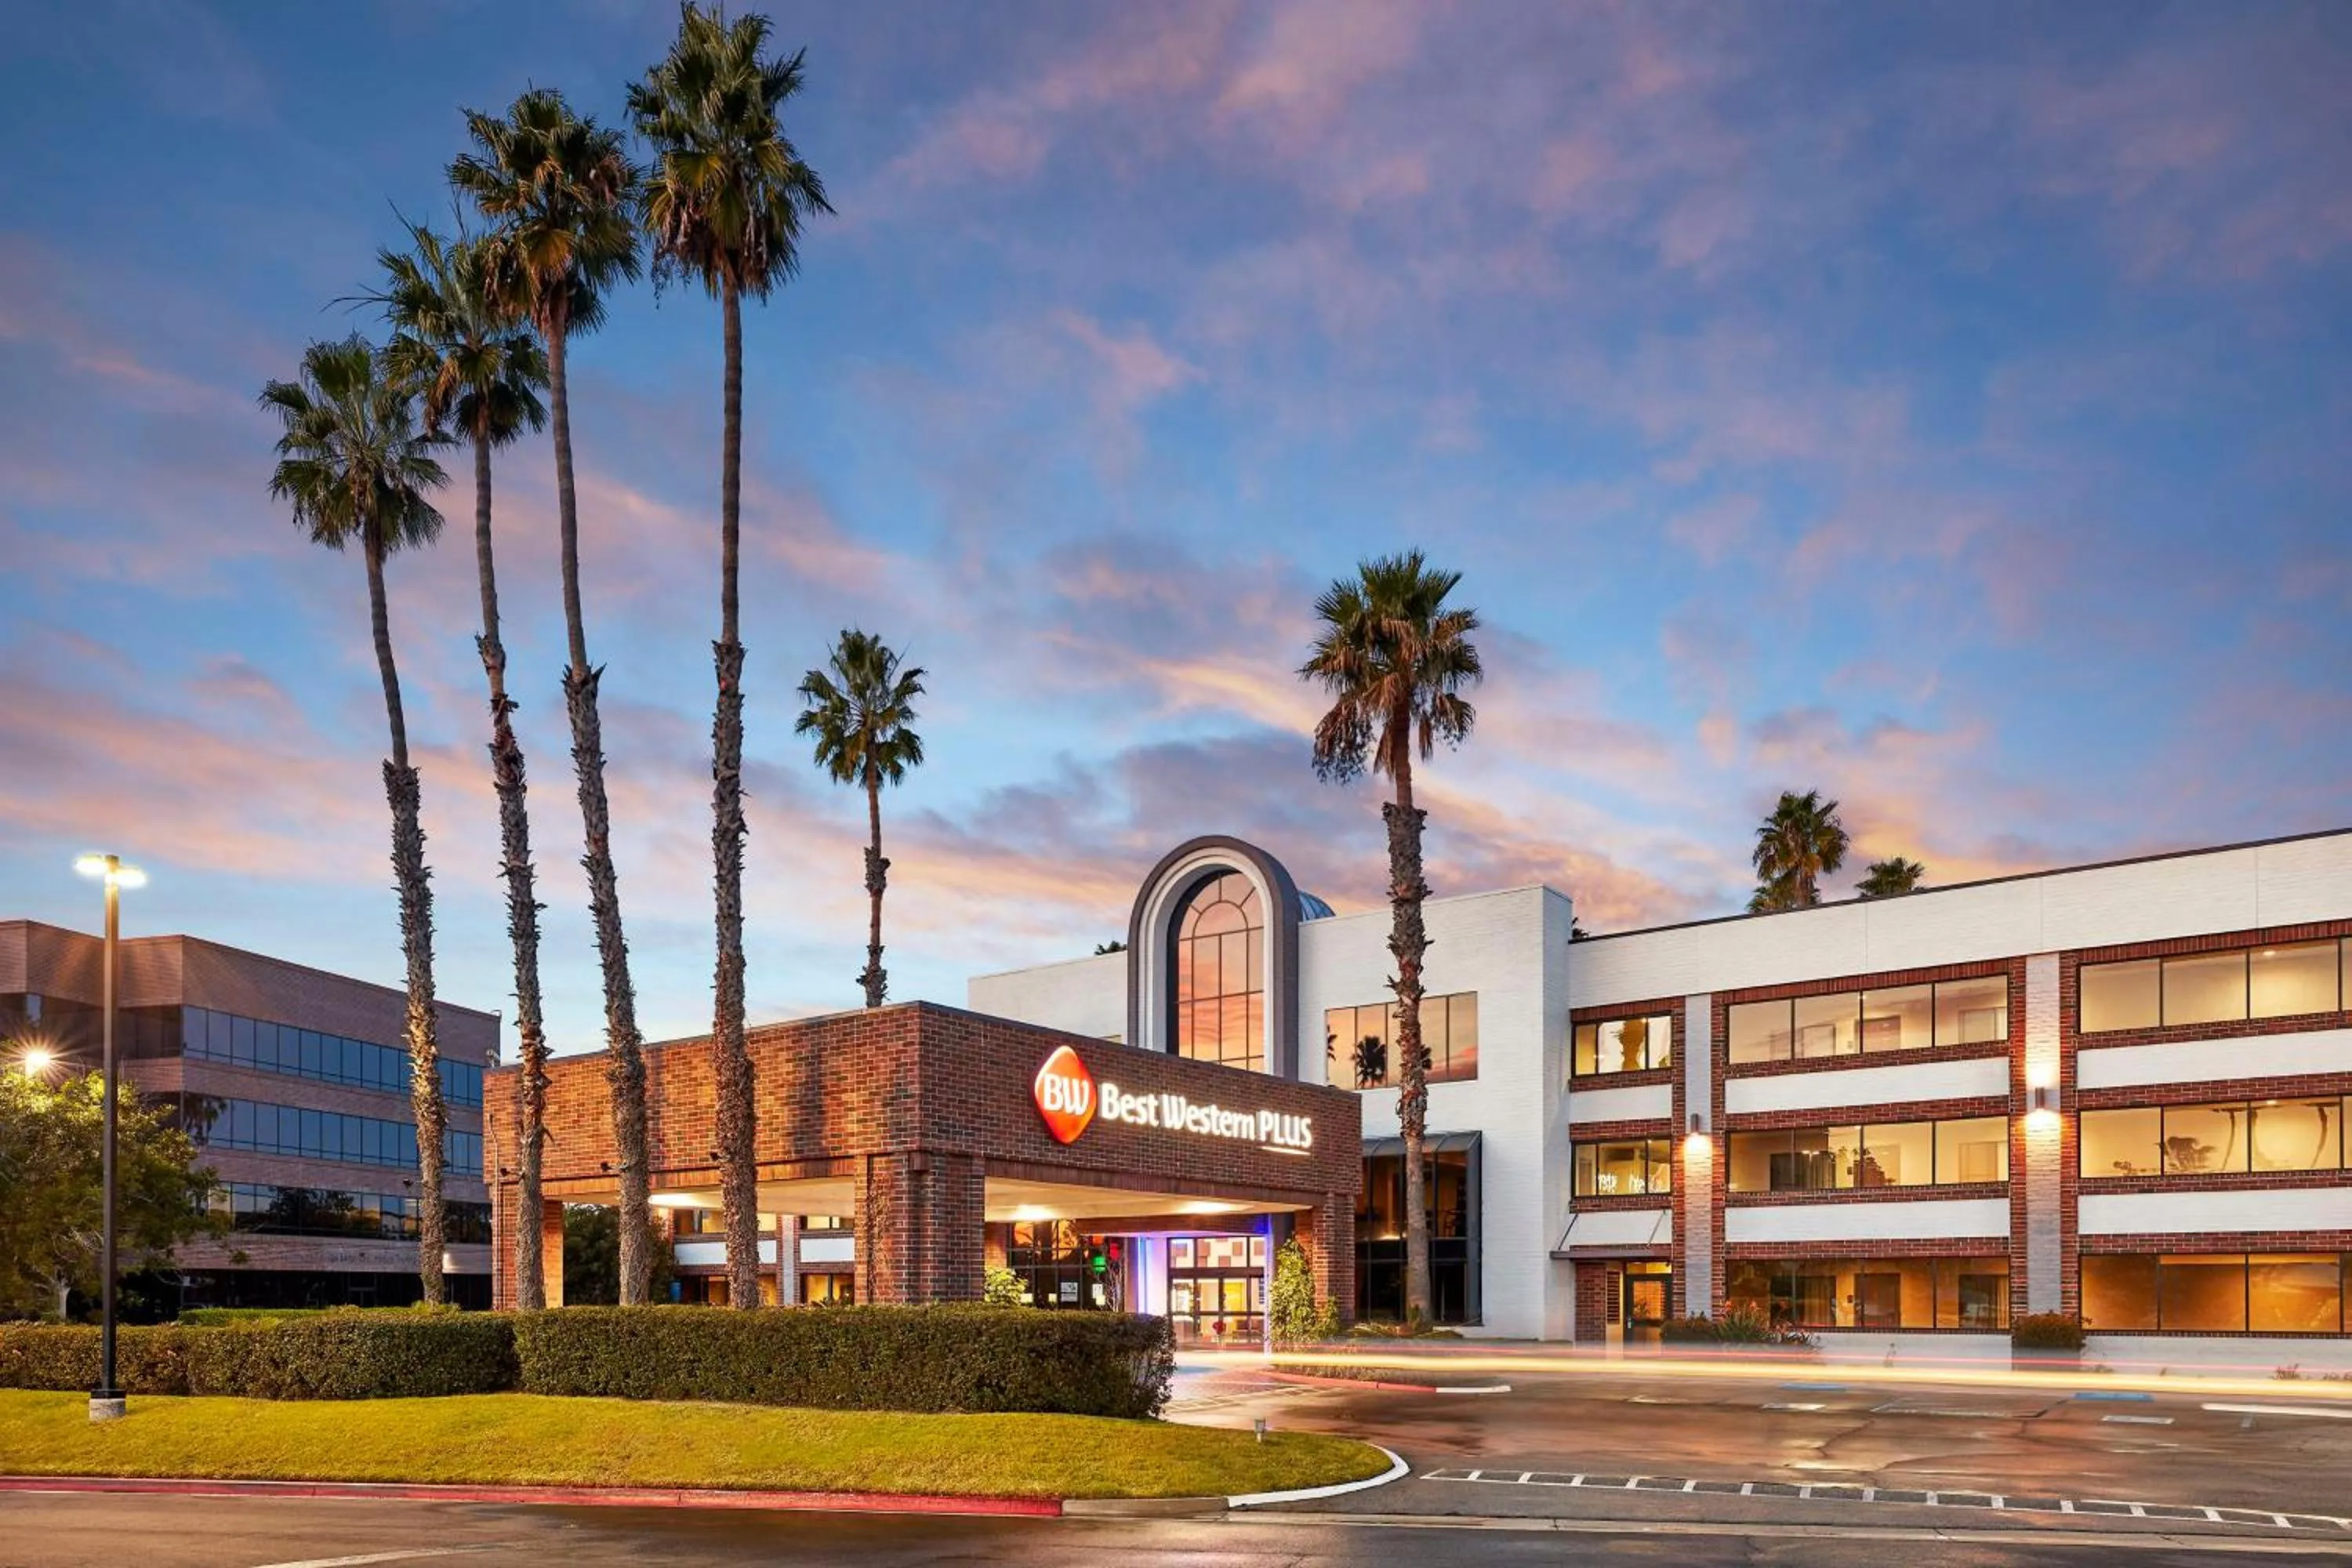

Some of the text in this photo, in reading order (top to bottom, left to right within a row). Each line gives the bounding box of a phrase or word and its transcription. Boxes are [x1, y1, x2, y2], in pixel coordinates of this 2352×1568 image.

[1043, 1073, 1090, 1116] BW
[1100, 1082, 1312, 1148] Best Western PLUS
